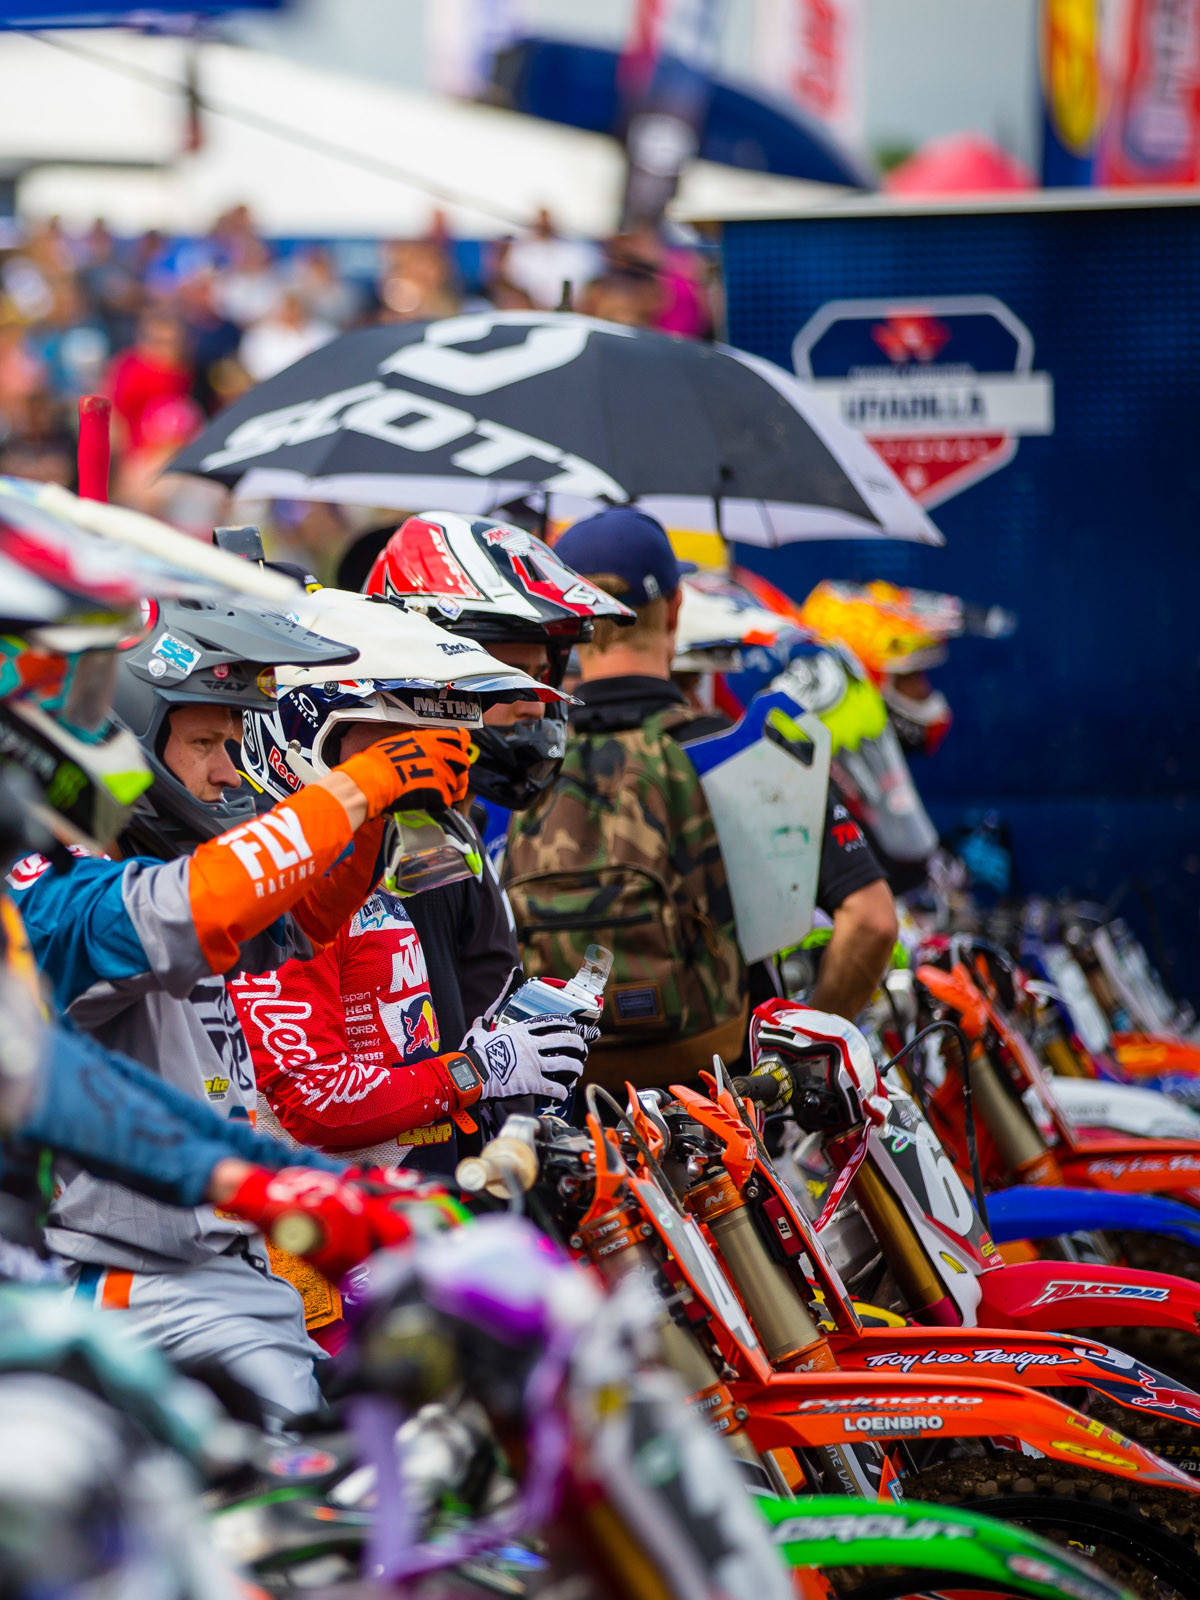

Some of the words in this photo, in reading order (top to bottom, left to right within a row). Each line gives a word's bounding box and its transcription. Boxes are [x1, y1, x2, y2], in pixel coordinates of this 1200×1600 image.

[289, 692, 319, 729] OAKLEY
[378, 737, 434, 786] FLY
[217, 806, 313, 880] FLY
[253, 860, 316, 898] RACING
[389, 933, 428, 993] KTM
[915, 1121, 974, 1237] 6
[1032, 1281, 1170, 1307] AMSOIL
[865, 1351, 921, 1373] Troy
[921, 1350, 970, 1364] Lee
[971, 1349, 1081, 1374] Designs
[798, 1395, 983, 1409] Palmetto
[843, 1415, 943, 1431] LOENBRO
